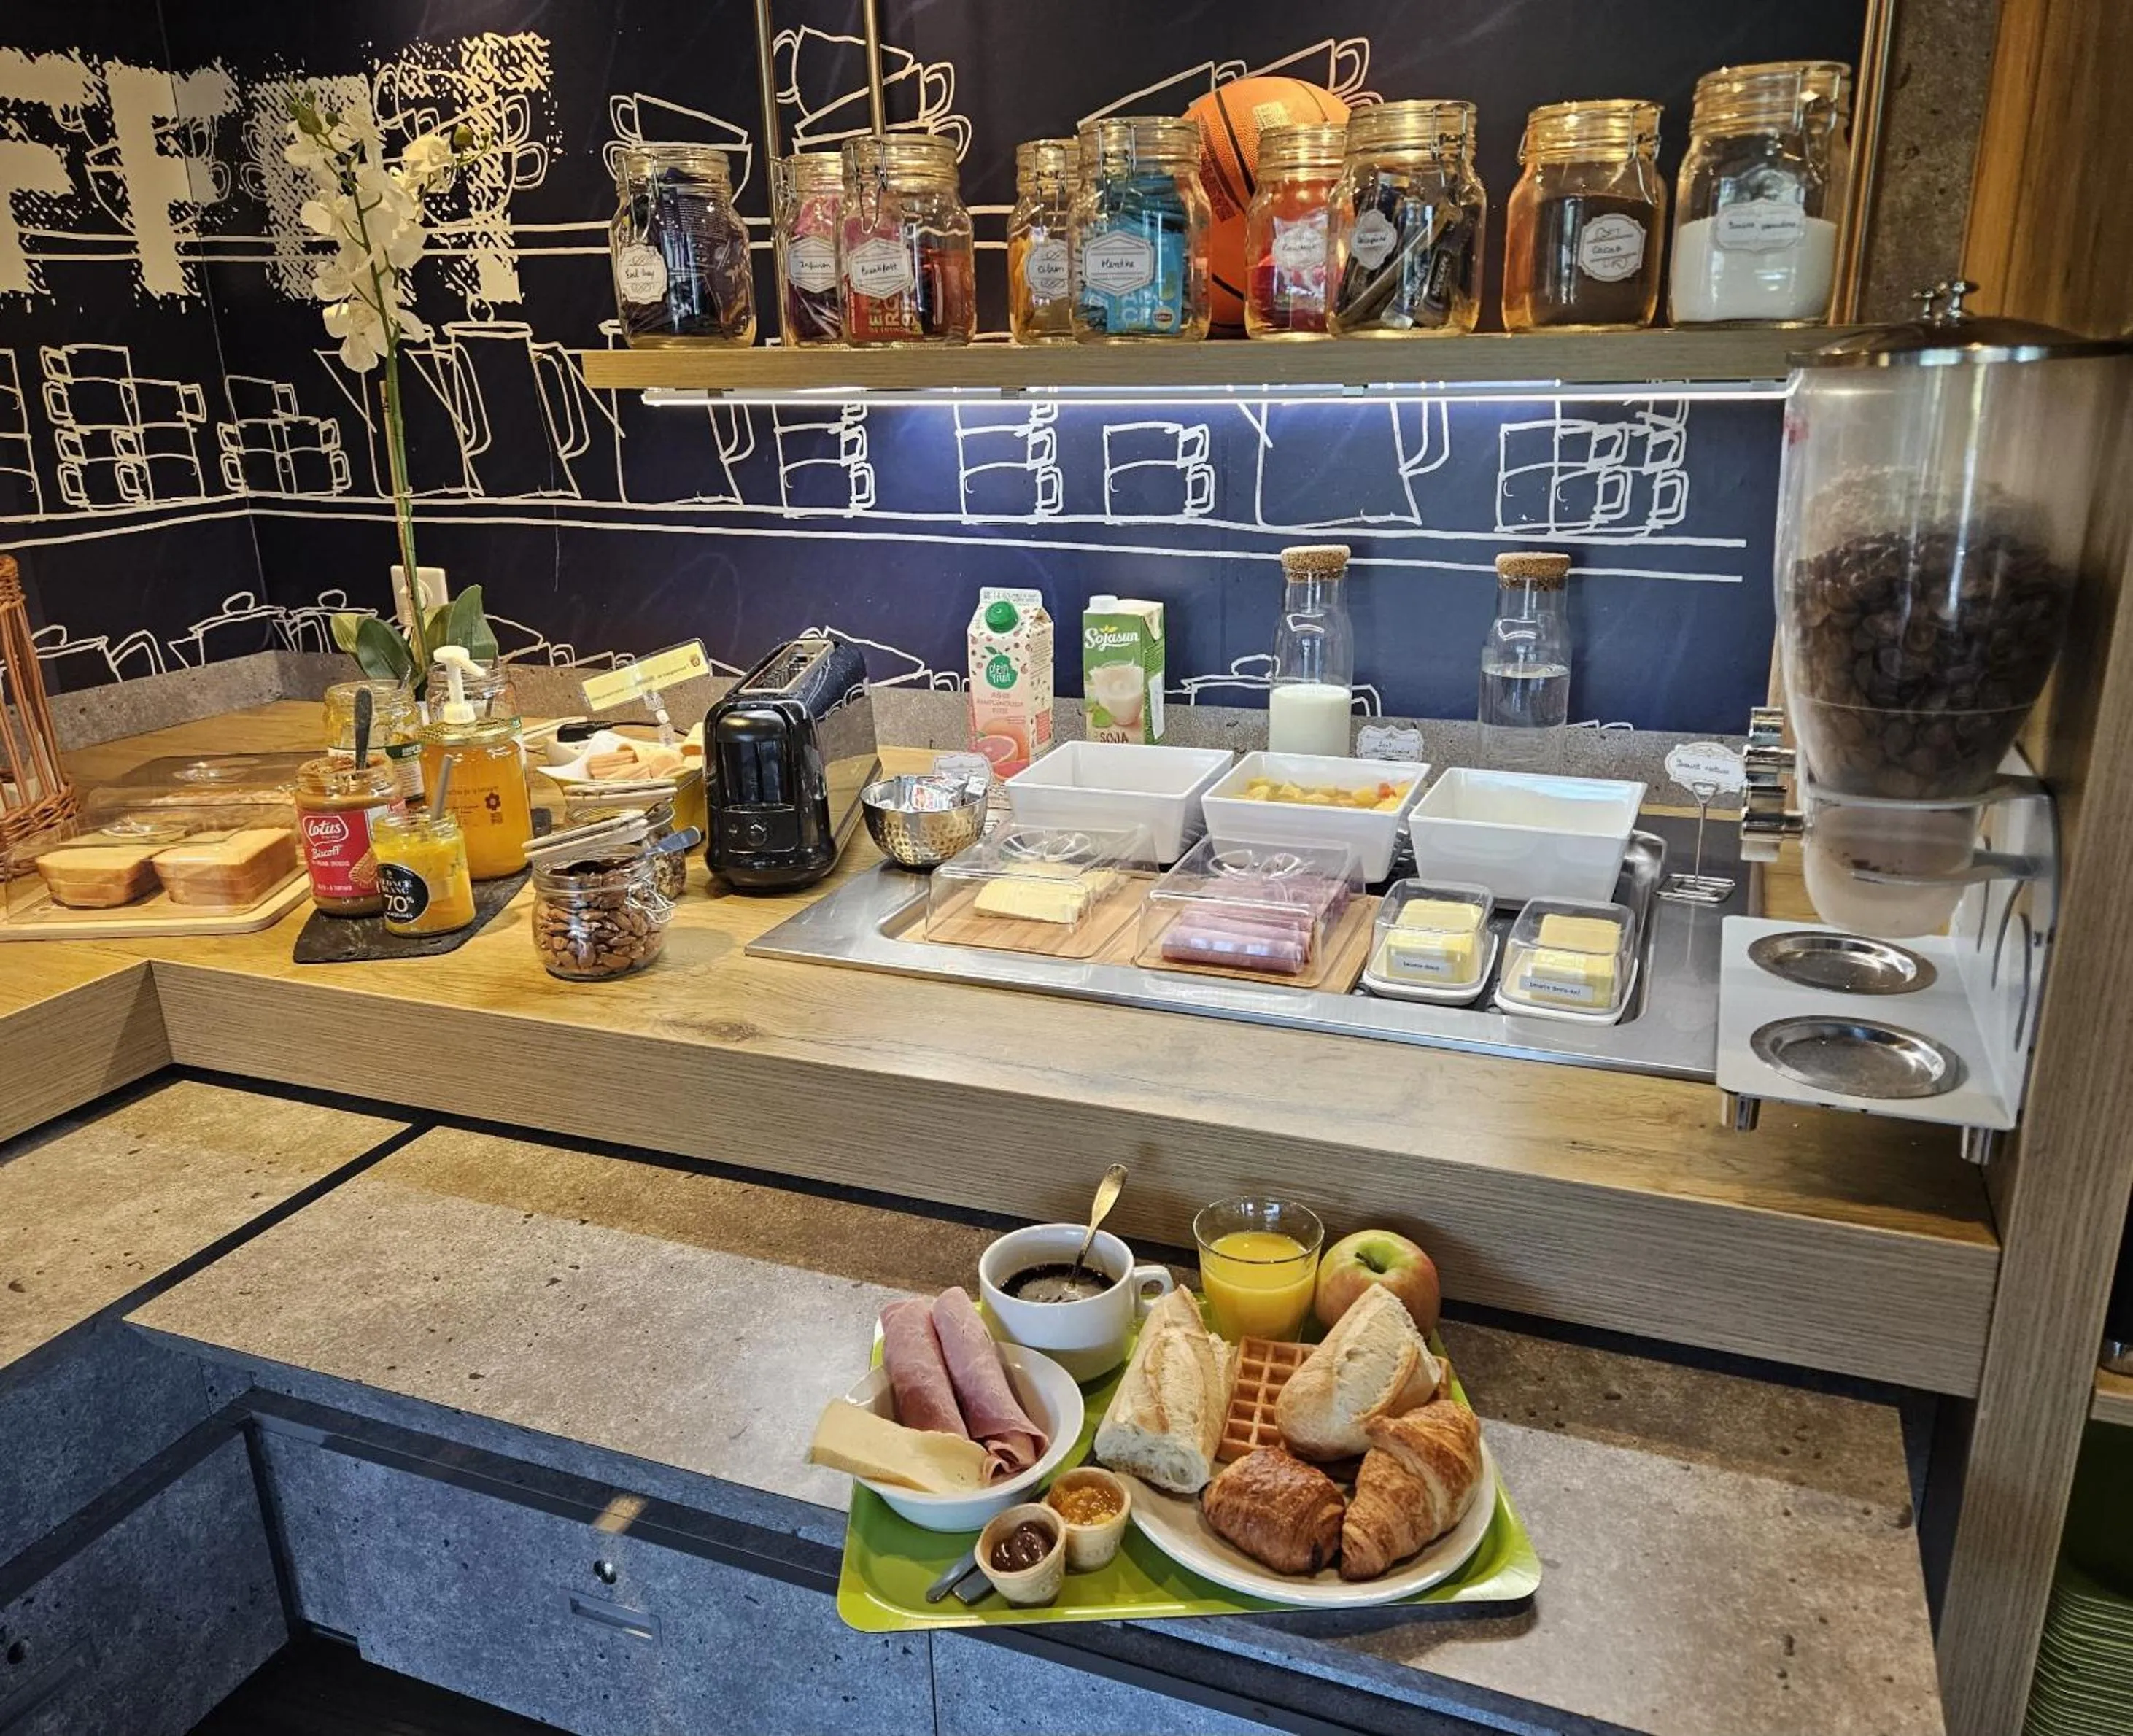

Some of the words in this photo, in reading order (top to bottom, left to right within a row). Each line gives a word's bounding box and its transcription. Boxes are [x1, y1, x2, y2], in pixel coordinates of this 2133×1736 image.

[1037, 262, 1065, 274] Citron
[1084, 627, 1140, 652] Sojasun
[1099, 732, 1129, 743] SOJA
[311, 844, 344, 860] Biscoff
